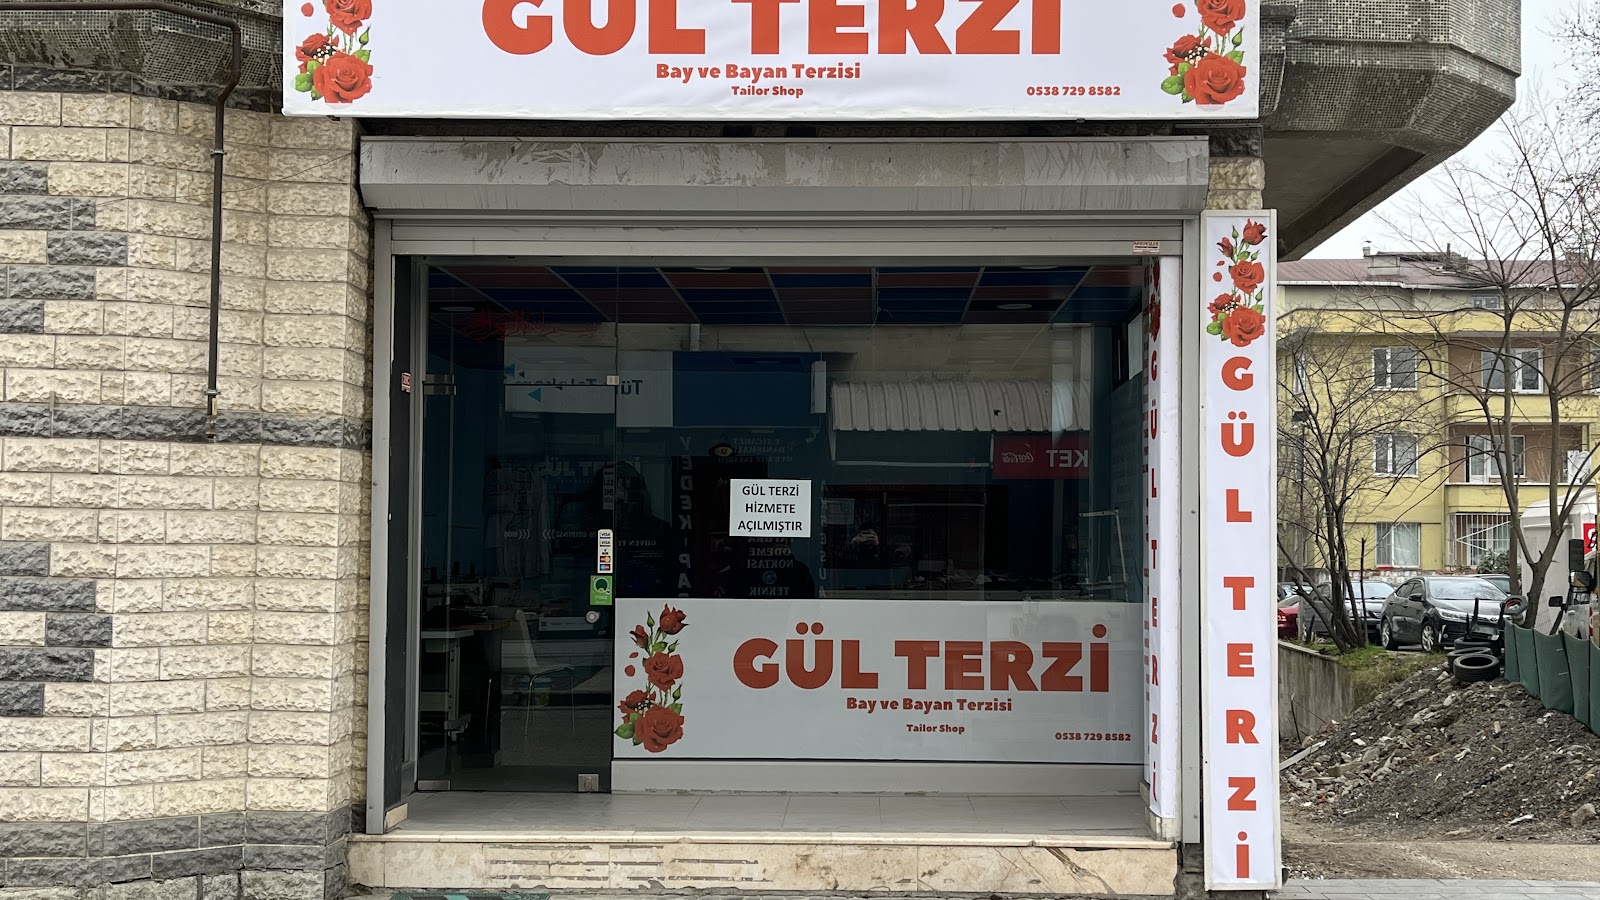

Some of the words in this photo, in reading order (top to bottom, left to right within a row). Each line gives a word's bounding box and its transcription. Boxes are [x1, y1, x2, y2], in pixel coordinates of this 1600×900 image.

[656, 63, 694, 83] Bay
[697, 66, 721, 79] ve
[725, 63, 788, 83] Bayan
[791, 62, 861, 79] Terzisi
[731, 85, 770, 96] Tailor
[773, 85, 804, 98] Shop
[1026, 85, 1059, 96] 0538
[1062, 85, 1086, 96] 729
[1089, 85, 1121, 96] 8582
[1221, 356, 1255, 522] GÜL
[741, 483, 766, 496] GÜL
[768, 484, 799, 496] TERZİ
[745, 501, 796, 514] HİZMETE
[737, 520, 803, 533] AÇILMIŞTIR
[733, 621, 879, 690] GÜL
[895, 623, 1110, 693] TERZİ
[846, 697, 877, 714] Bay
[879, 699, 899, 711] ve
[903, 697, 953, 715] Bayan
[957, 697, 1013, 712] Terzisi
[906, 724, 937, 733] Tailor
[939, 724, 965, 735] Shop
[1223, 576, 1258, 878] TERZİ
[1055, 732, 1082, 741] 0538
[1083, 732, 1103, 741] 729
[1105, 732, 1132, 741] 8582
